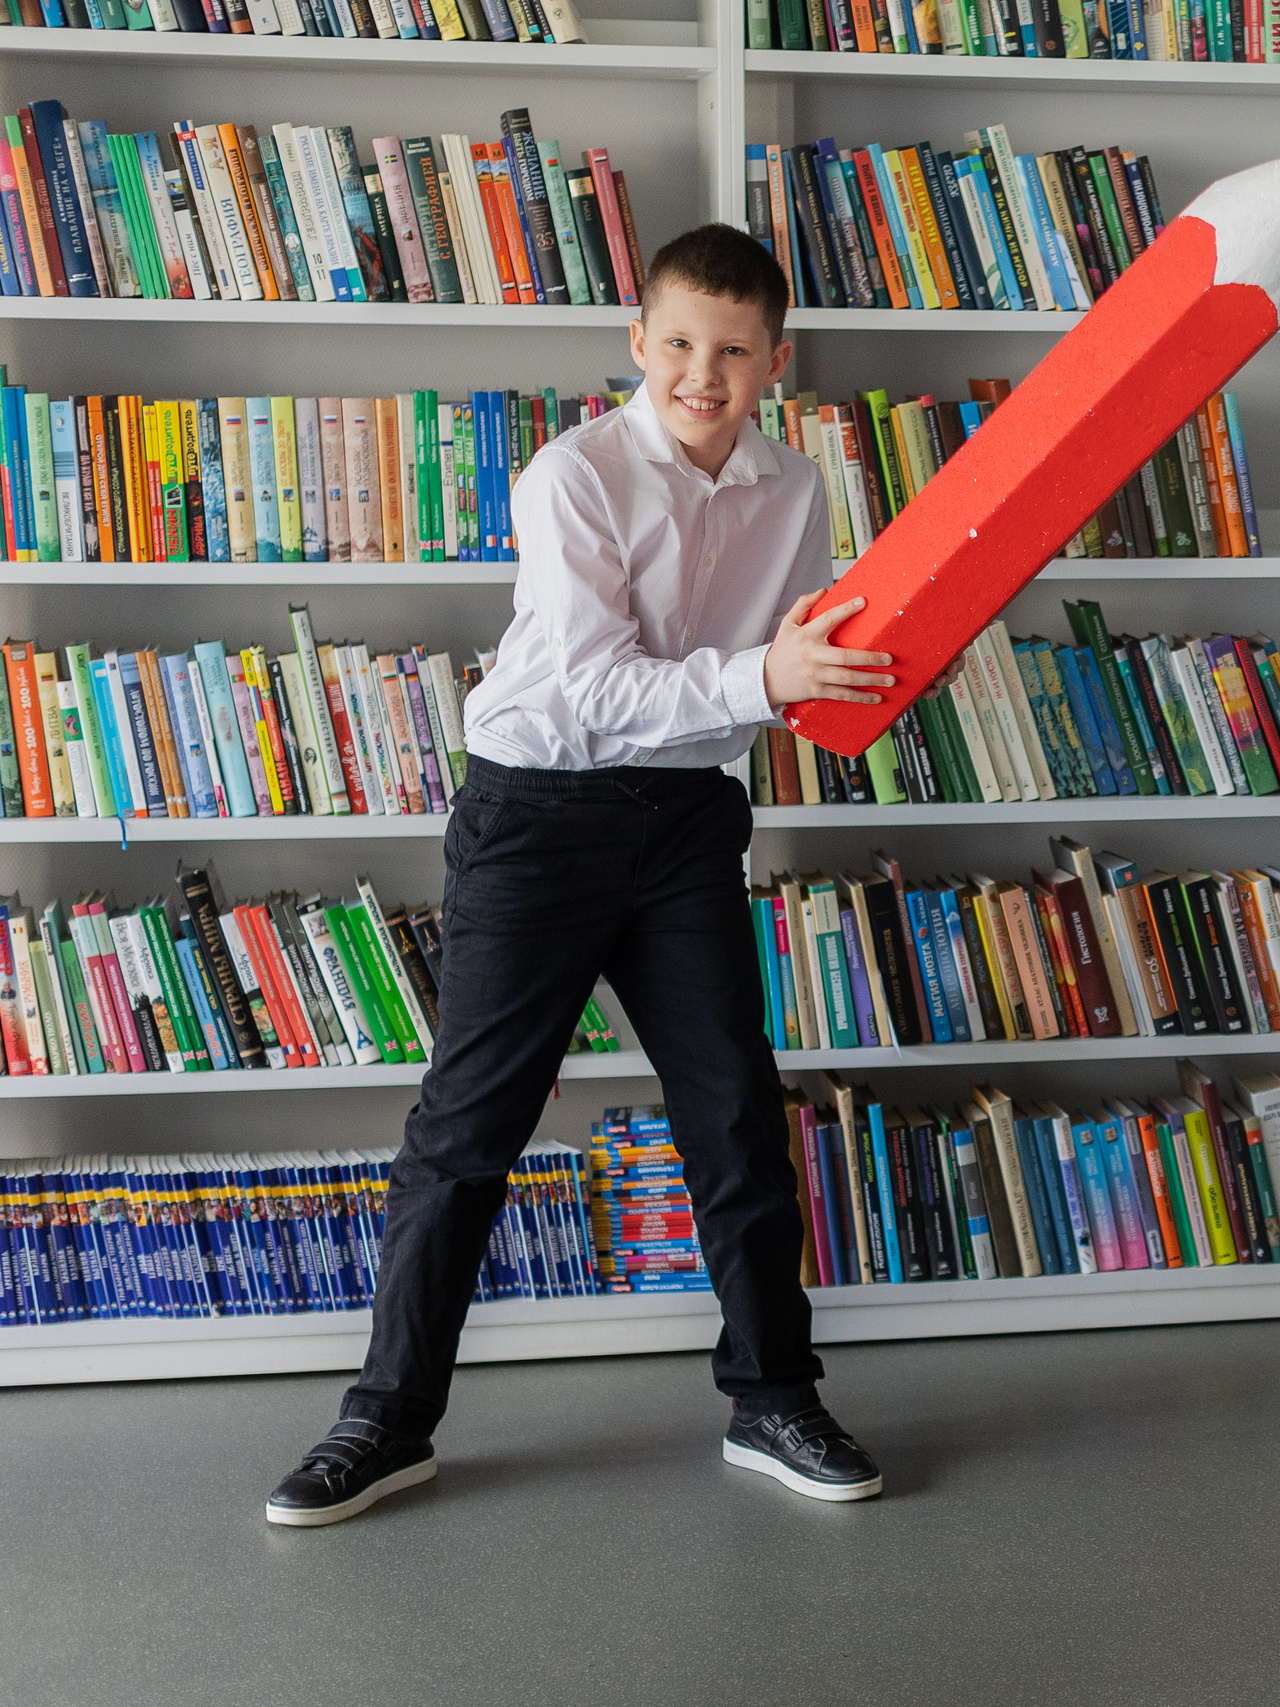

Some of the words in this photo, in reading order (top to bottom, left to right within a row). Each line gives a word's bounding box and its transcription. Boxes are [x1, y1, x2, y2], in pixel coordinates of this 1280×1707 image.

[299, 135, 314, 167] РУССКИЕ
[521, 129, 545, 200] ЖЕЛАНИЕ
[921, 148, 937, 175] РЫБЫ
[19, 164, 35, 211] КРАЕВЕДЕНИЕ
[60, 178, 70, 192] НА
[229, 149, 250, 205] ГЕОГРАФИЯ
[308, 169, 322, 196] ИМЕНА
[517, 158, 533, 201] ГОРОДОМ
[1084, 179, 1095, 192] КАК
[7, 193, 20, 222] МИРА
[289, 170, 317, 241] ГЕОГРАФИЯ
[315, 197, 325, 208] НА
[372, 196, 389, 236] АМЕРИКА
[419, 155, 449, 247] ГЕОГРАФИЕЙ
[929, 177, 956, 247] ЭКЗОТИЧЕСКИЕ
[995, 190, 1007, 208] ЭТА
[1088, 193, 1105, 228] МИКРОБЫ
[13, 225, 27, 254] АТЛАС
[63, 196, 82, 253] ПЛАВАНИЕ
[244, 207, 267, 270] ФИЗИЧЕСКАЯ
[318, 210, 332, 233] КАРТЕ
[1001, 211, 1015, 240] КНИГА
[220, 197, 254, 287] ГЕОГРАФИЯ
[325, 234, 340, 265] ЕВРАЗИИ
[439, 251, 451, 259] С
[537, 232, 555, 249] 35
[1009, 241, 1019, 254] НЕ
[1039, 216, 1061, 267] АКВАРИУМ
[1098, 229, 1116, 268] УПРАВЛЯЮТ
[847, 251, 865, 292] ОСНОВЫ
[1012, 254, 1027, 287] МУСОР
[127, 417, 135, 433] ЧТО
[95, 434, 104, 462] ОТКРОЙ
[128, 435, 137, 463] ТАКОЕ
[97, 464, 105, 478] ДЛЯ
[441, 447, 454, 486] Египет
[98, 480, 107, 498] СЕБЯ
[130, 465, 140, 516] БАРСЕЛОНА
[1239, 473, 1253, 513] АНАТОМИЯ
[61, 491, 74, 556] ВЕЛИКОБРИТАНИЯ
[100, 500, 109, 527] ЕГИПЕТ
[165, 508, 179, 555] ПЕКИН
[983, 655, 998, 681] КУСТО
[19, 686, 30, 708] 100
[1104, 661, 1129, 719] ПОЗВОНОЧНЫХ
[24, 726, 35, 749] 100
[46, 704, 60, 741] ЛИТВА
[314, 690, 332, 753] ПУТЕШЕСТВИЯ
[1122, 721, 1142, 761] ЗООЛОГИЯ
[197, 902, 223, 951] МИРА
[364, 893, 383, 924] ЗАГАДКА
[896, 889, 912, 945] АНТРОПОЛОГИЯ
[1233, 912, 1246, 936] КАК
[376, 926, 403, 978] МАЛЬДИВСКАЯ
[824, 934, 840, 969] ЗООЛОГИЯ
[1017, 918, 1031, 950] ЧЕЛОВЕКА
[1070, 911, 1092, 964] Гистология
[882, 928, 899, 977] человека
[922, 941, 936, 977] МОЗГА
[1025, 951, 1039, 985] АНАТОМИИ
[1144, 957, 1158, 973] 50
[212, 954, 245, 1025] СТРАНЫ
[322, 946, 356, 1010] ФРАНЦИЯ
[960, 966, 974, 1003] ПСИХОЛОГИЯ
[829, 970, 848, 1030] БЕСПОЗВОНОЧНЫХ
[890, 978, 908, 1036] Анатомия
[929, 978, 944, 1017] МАГИЯ
[1033, 987, 1044, 1007] АТЛАС
[43, 1010, 55, 1036] ПОЛО
[75, 1002, 97, 1059] ТУРЦИЯ
[204, 1023, 222, 1057] СОЧИ
[48, 1037, 61, 1068] МАРКО
[806, 1126, 816, 1160] ЧЕЛОВЕКА
[891, 1130, 901, 1165] ЧЕЛОВЕКА
[811, 1161, 820, 1197] АНАТОМИЯ
[895, 1167, 907, 1206] ЭВОЛЮЦИЯ
[1061, 1163, 1074, 1198] ВООБЩЕ
[1237, 1163, 1251, 1210] ИЗНАЧАЛЬНЫЙ
[1207, 1187, 1222, 1228] обезьяна
[1246, 1211, 1257, 1239] ЧЕЛОВЕК
[872, 1211, 882, 1248] БИОЛОГИЯ
[877, 1249, 885, 1268] ВЕРЫ
